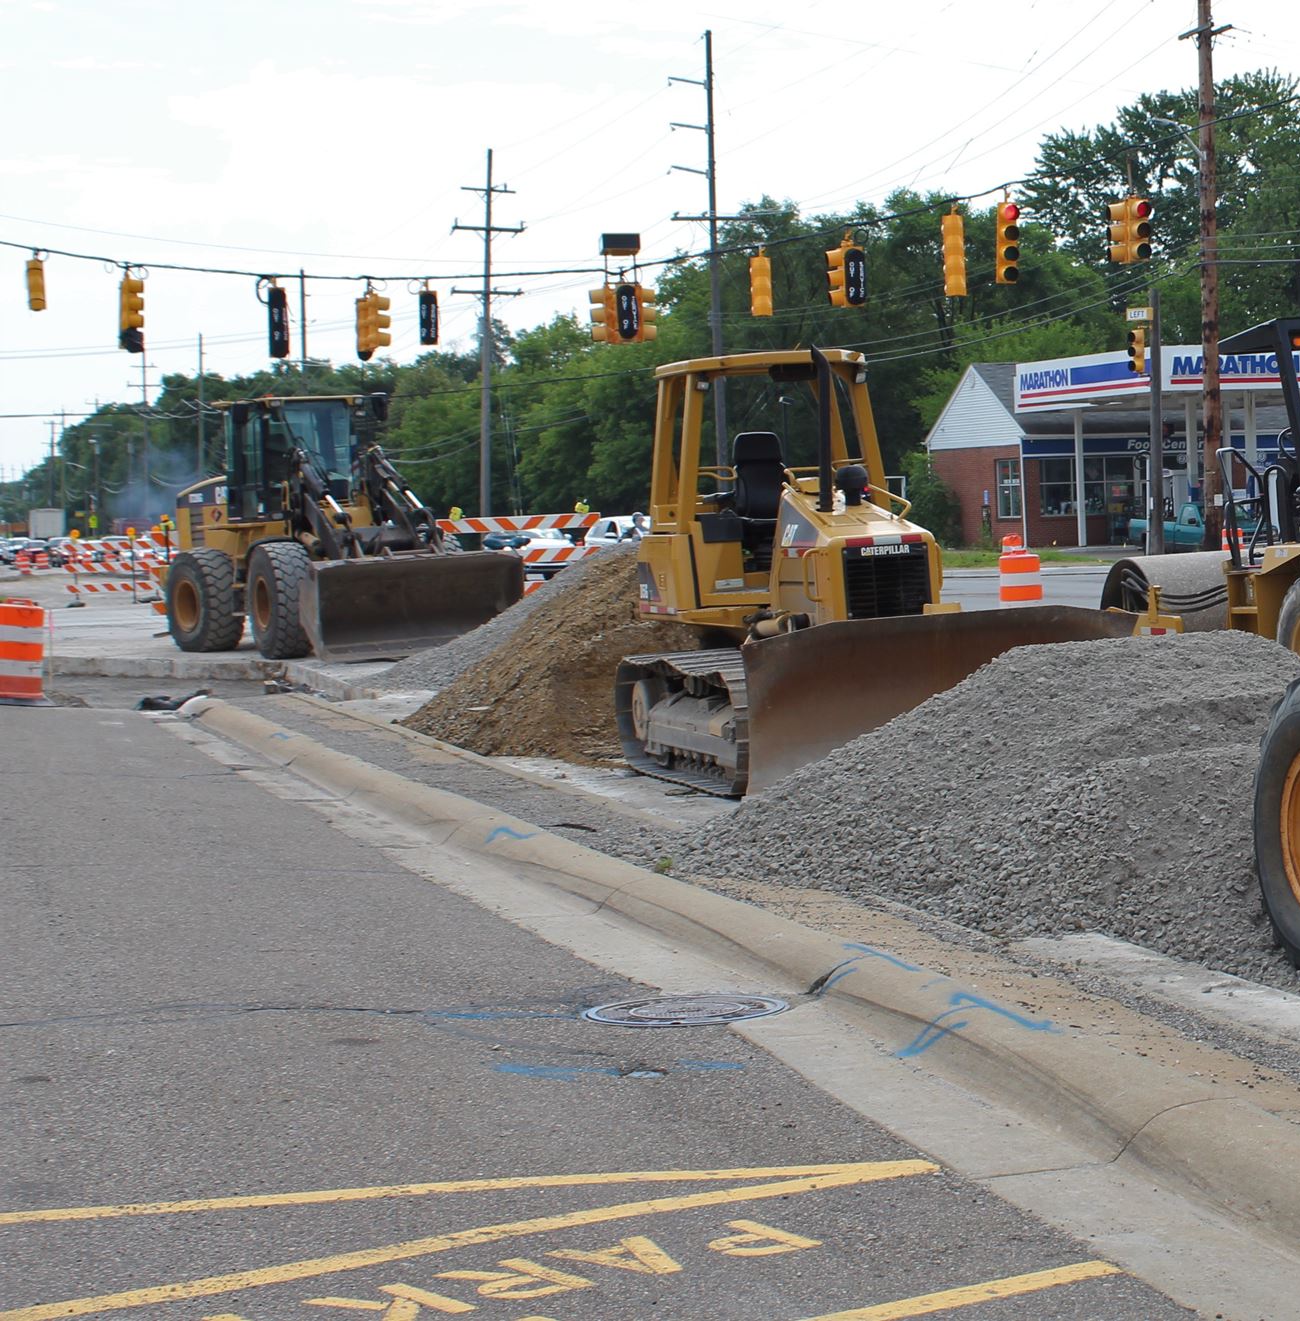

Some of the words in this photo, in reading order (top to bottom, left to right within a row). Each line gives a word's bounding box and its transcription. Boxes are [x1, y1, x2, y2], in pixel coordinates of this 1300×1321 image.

[1129, 310, 1145, 318] LEFT
[1020, 369, 1069, 391] MARATHON
[1127, 439, 1150, 450] Foo
[1162, 438, 1204, 450] Cenr
[781, 524, 799, 547] CAT
[861, 544, 910, 557] CATERPILLAR
[202, 1218, 824, 1321] PARK
